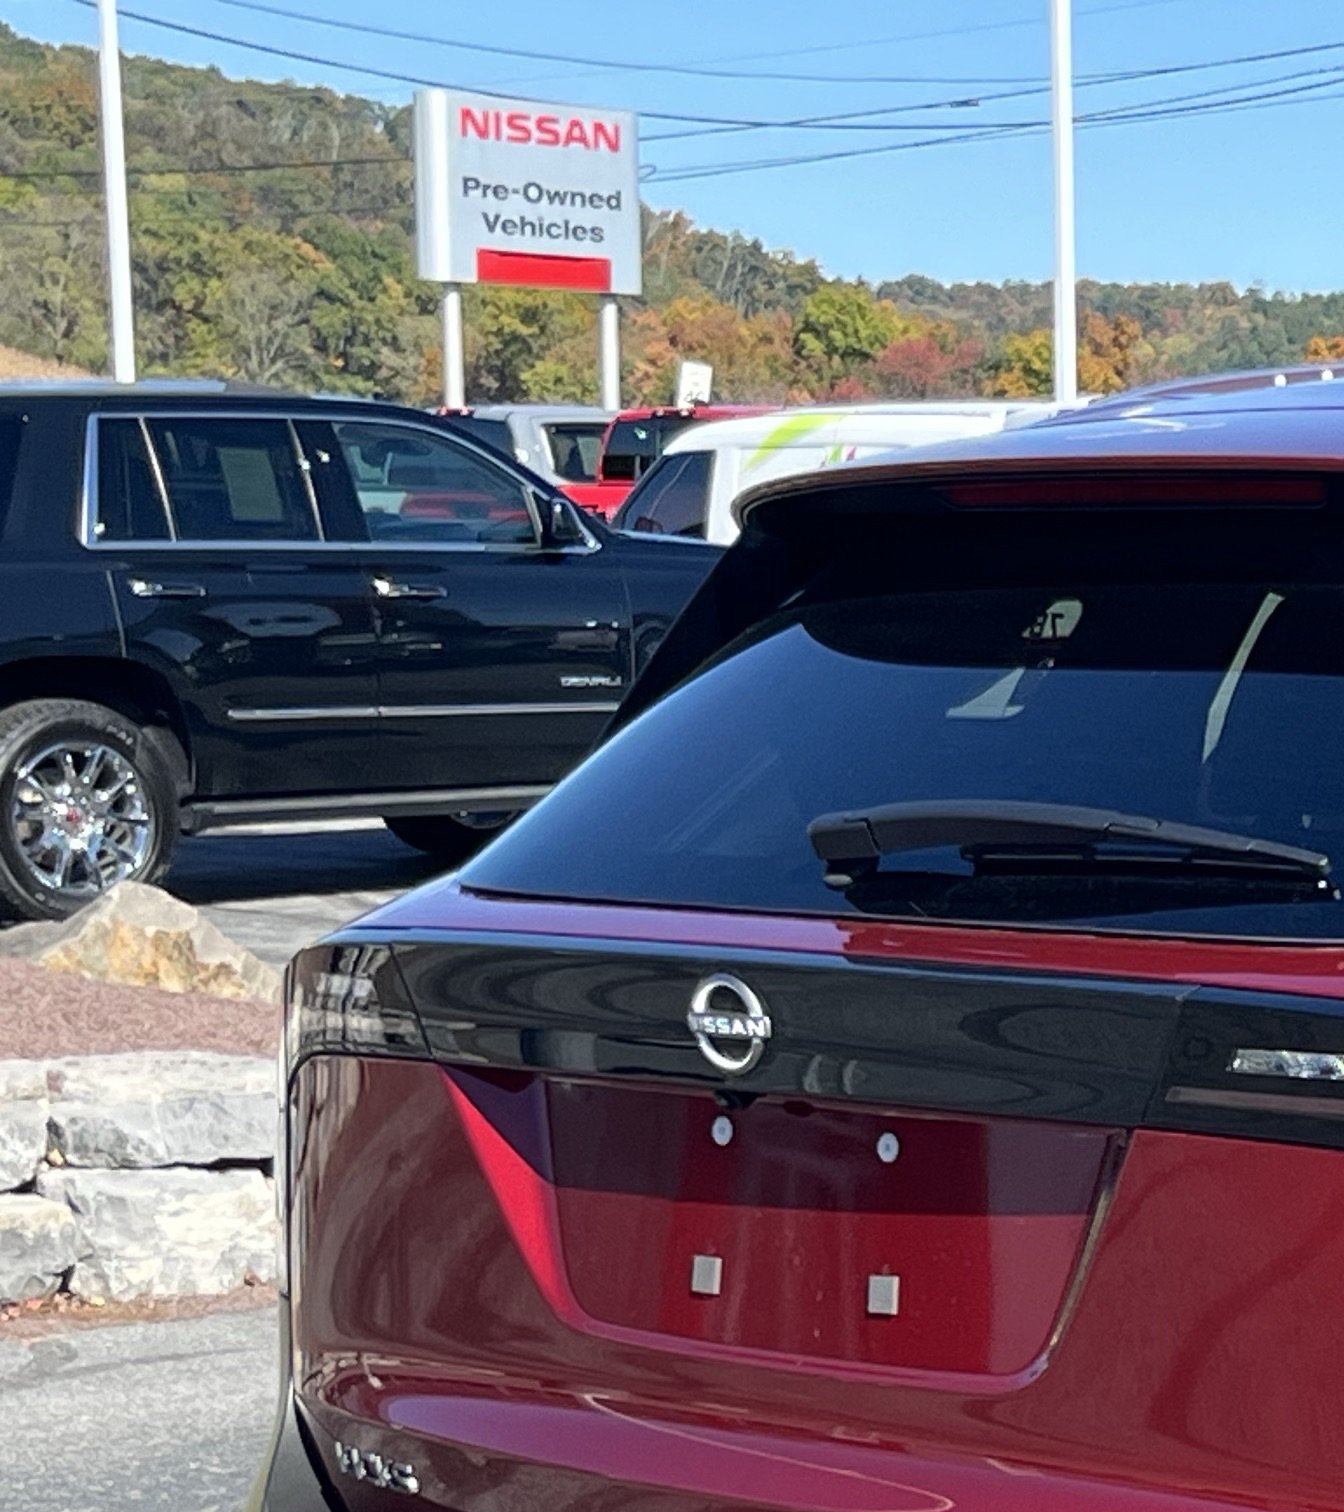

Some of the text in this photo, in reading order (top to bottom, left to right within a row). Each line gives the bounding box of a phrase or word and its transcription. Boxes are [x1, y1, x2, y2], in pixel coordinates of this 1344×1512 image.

[459, 107, 622, 154] NISSAN
[462, 176, 622, 211] Pre-Owned
[481, 212, 605, 243] Vehicles
